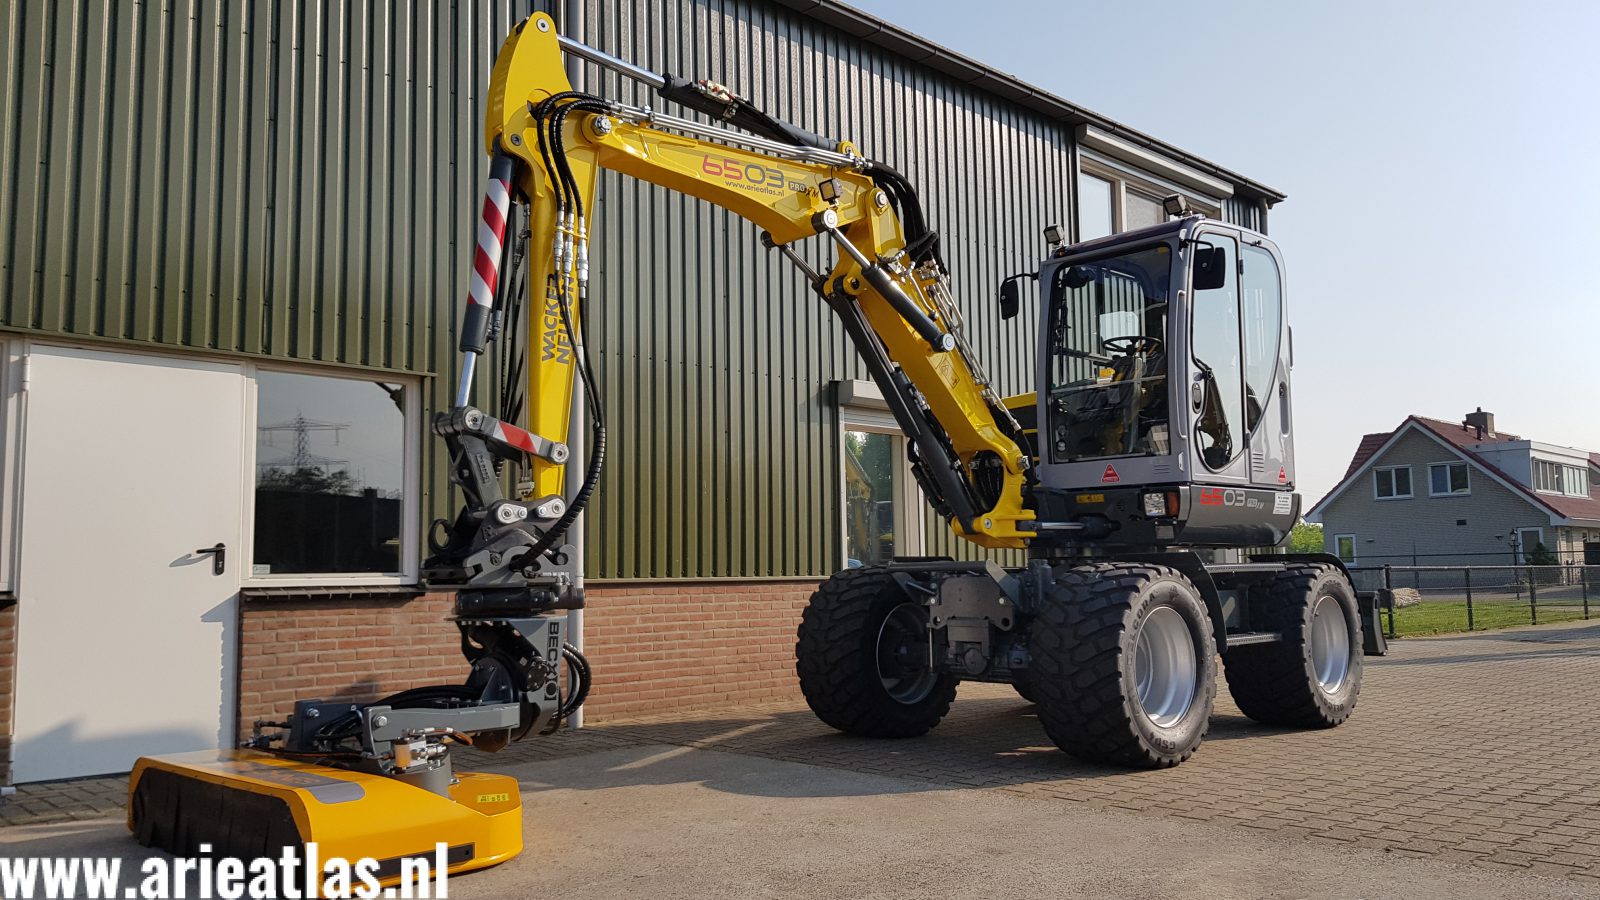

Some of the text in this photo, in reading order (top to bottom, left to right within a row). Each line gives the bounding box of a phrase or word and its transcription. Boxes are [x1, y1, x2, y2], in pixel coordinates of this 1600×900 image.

[702, 154, 785, 188] 6503
[789, 182, 806, 192] PRO
[725, 181, 784, 197] www.arieatlas.nl
[541, 273, 558, 361] WACKER
[1200, 488, 1246, 507] 6503
